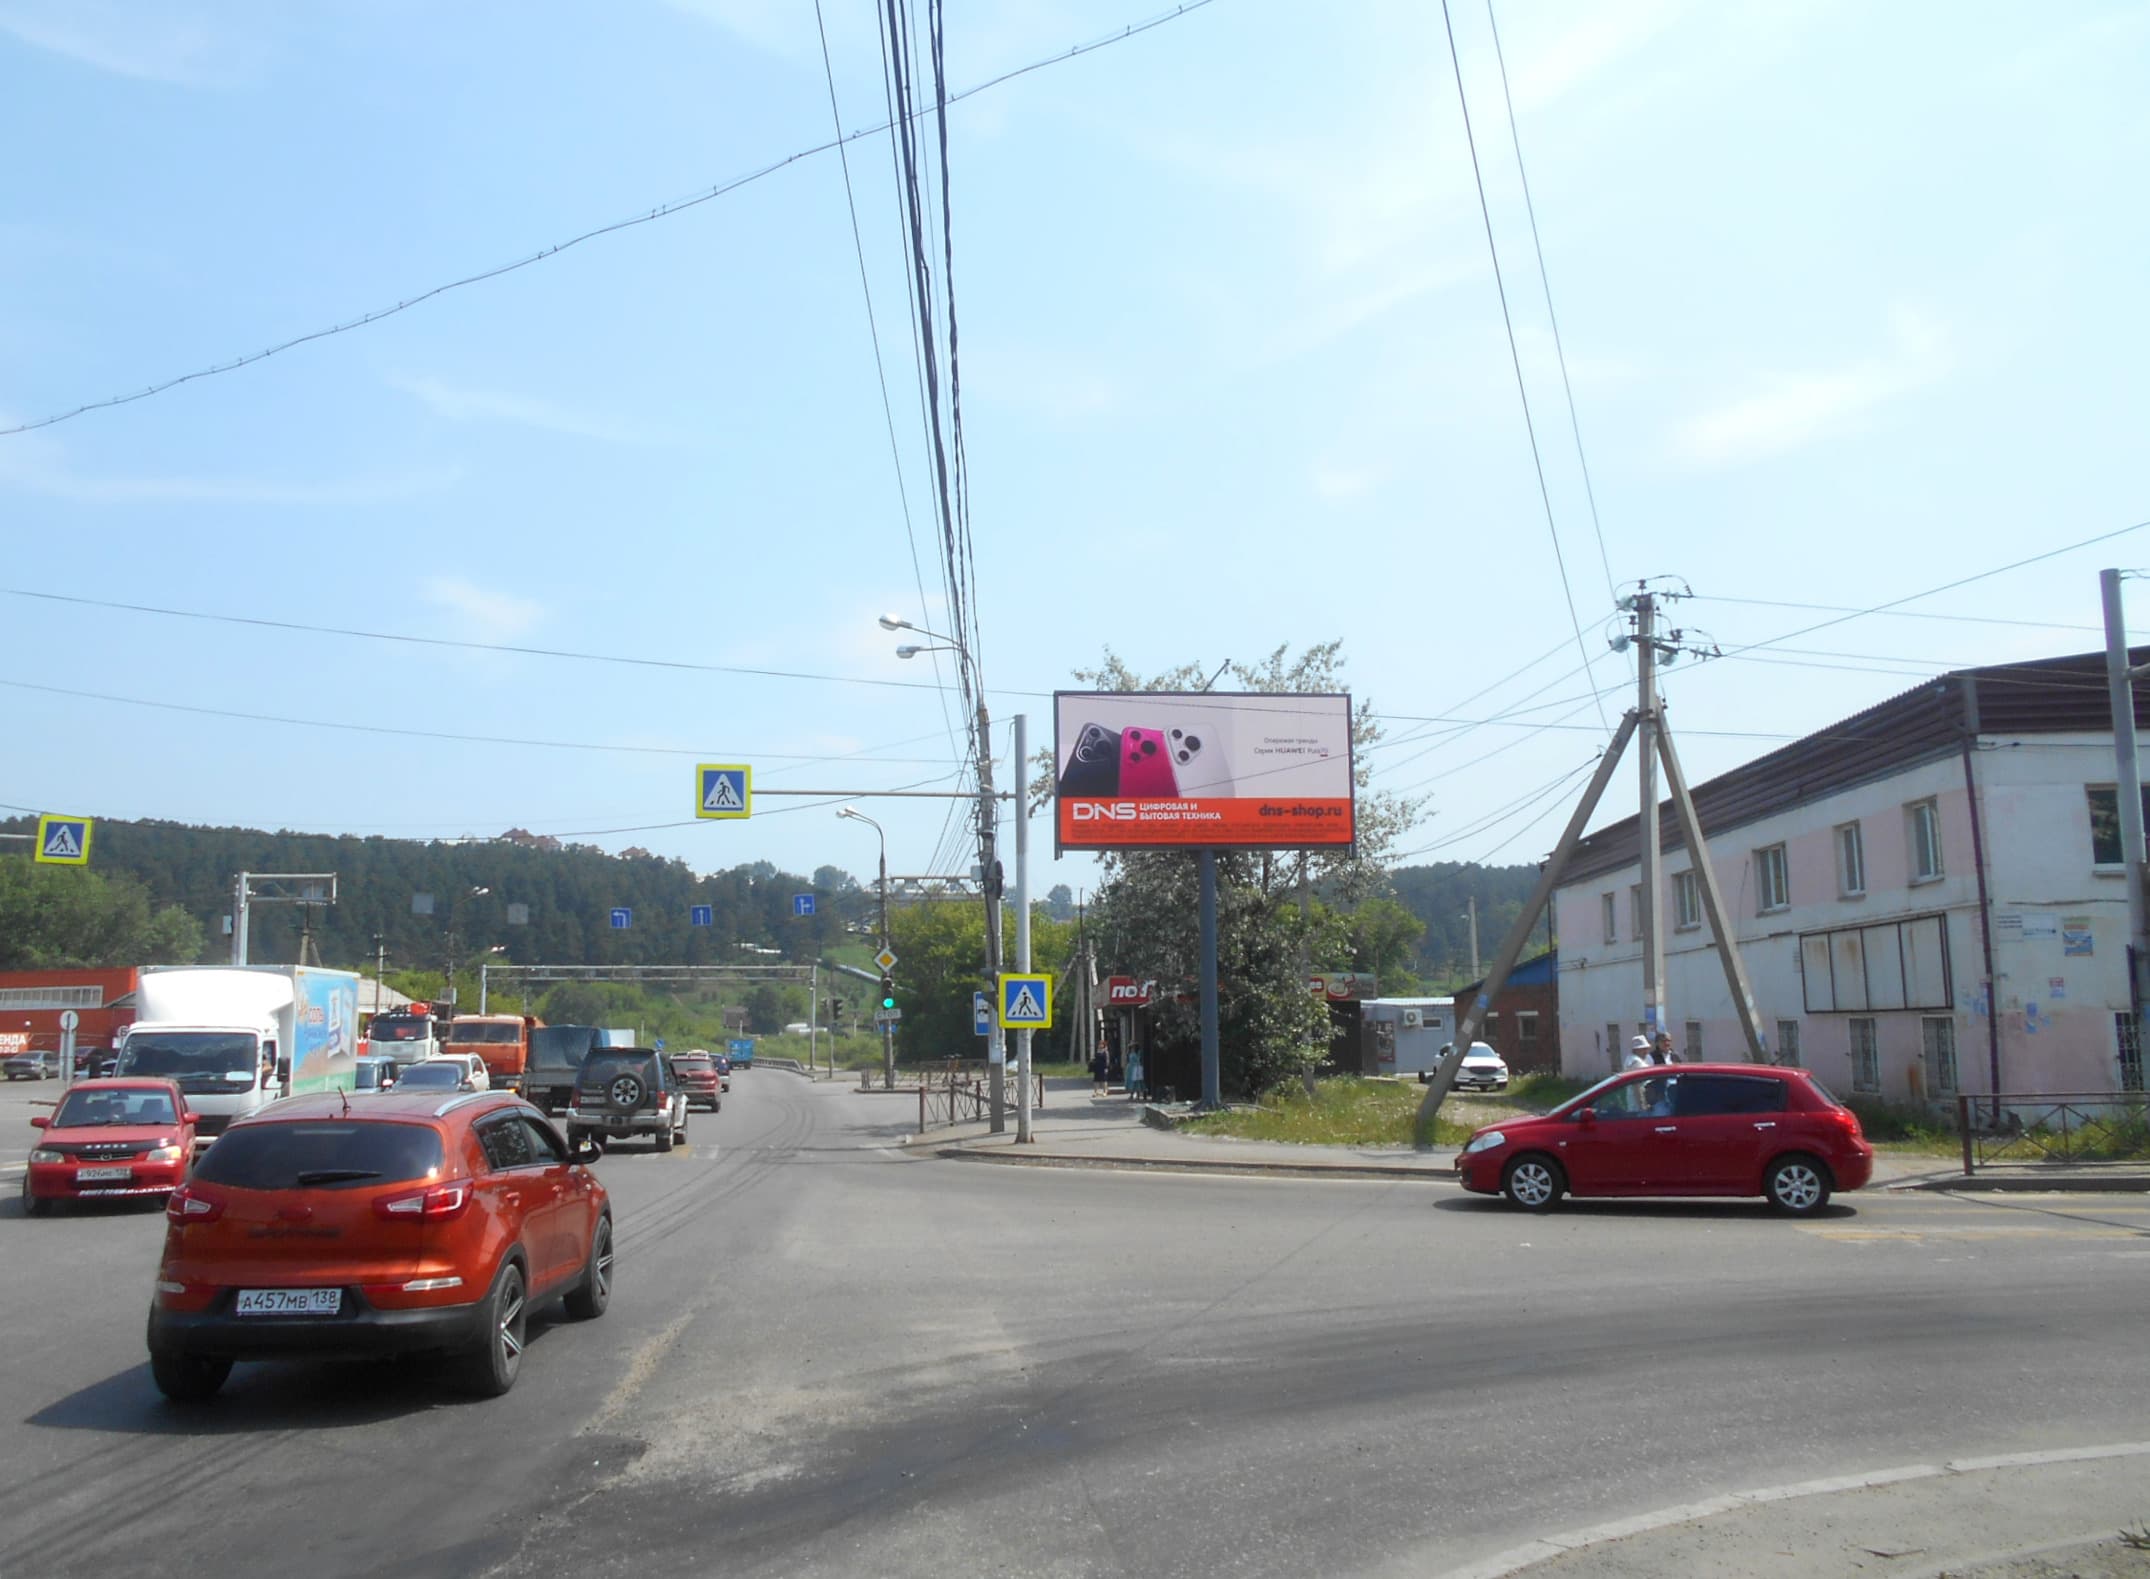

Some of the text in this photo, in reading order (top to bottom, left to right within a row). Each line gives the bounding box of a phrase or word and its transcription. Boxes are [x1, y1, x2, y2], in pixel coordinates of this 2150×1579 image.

[1072, 803, 1137, 820] DNS
[1139, 802, 1188, 811] ЦИФРОВАЯ
[1258, 804, 1343, 818] dns-shop.ru
[1139, 812, 1221, 820] БЫТОВАЯ ТЕХНИКА
[312, 1290, 337, 1305] 138
